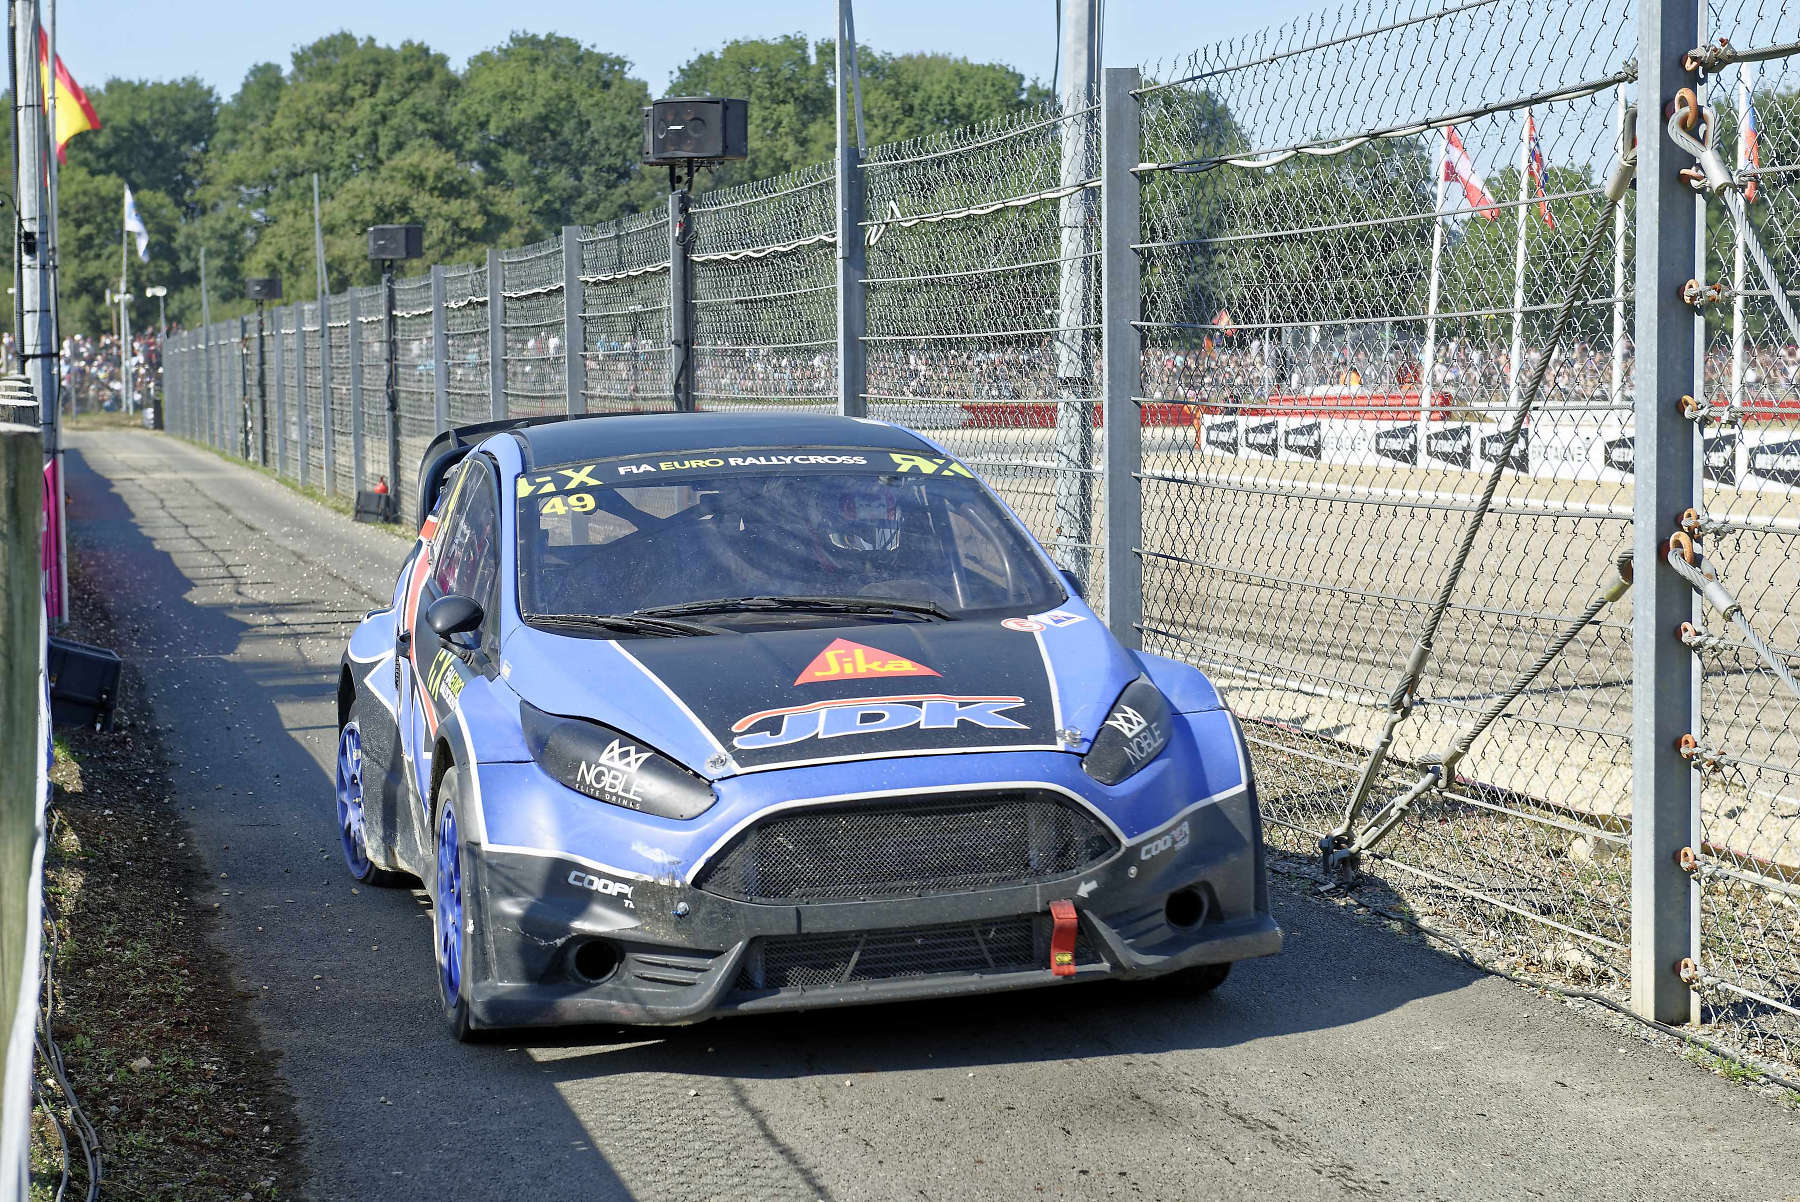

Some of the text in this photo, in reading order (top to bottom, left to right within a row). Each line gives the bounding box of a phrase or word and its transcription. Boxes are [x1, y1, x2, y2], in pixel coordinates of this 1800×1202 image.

[617, 455, 868, 475] FIA EURO RALLYCROSS
[541, 493, 596, 515] 49
[814, 648, 918, 677] Sika
[732, 700, 1031, 750] JDK
[1122, 721, 1164, 766] NOBLE
[576, 760, 644, 802] NOBLE
[605, 793, 641, 810] DRINKS
[567, 870, 634, 899] COOP
